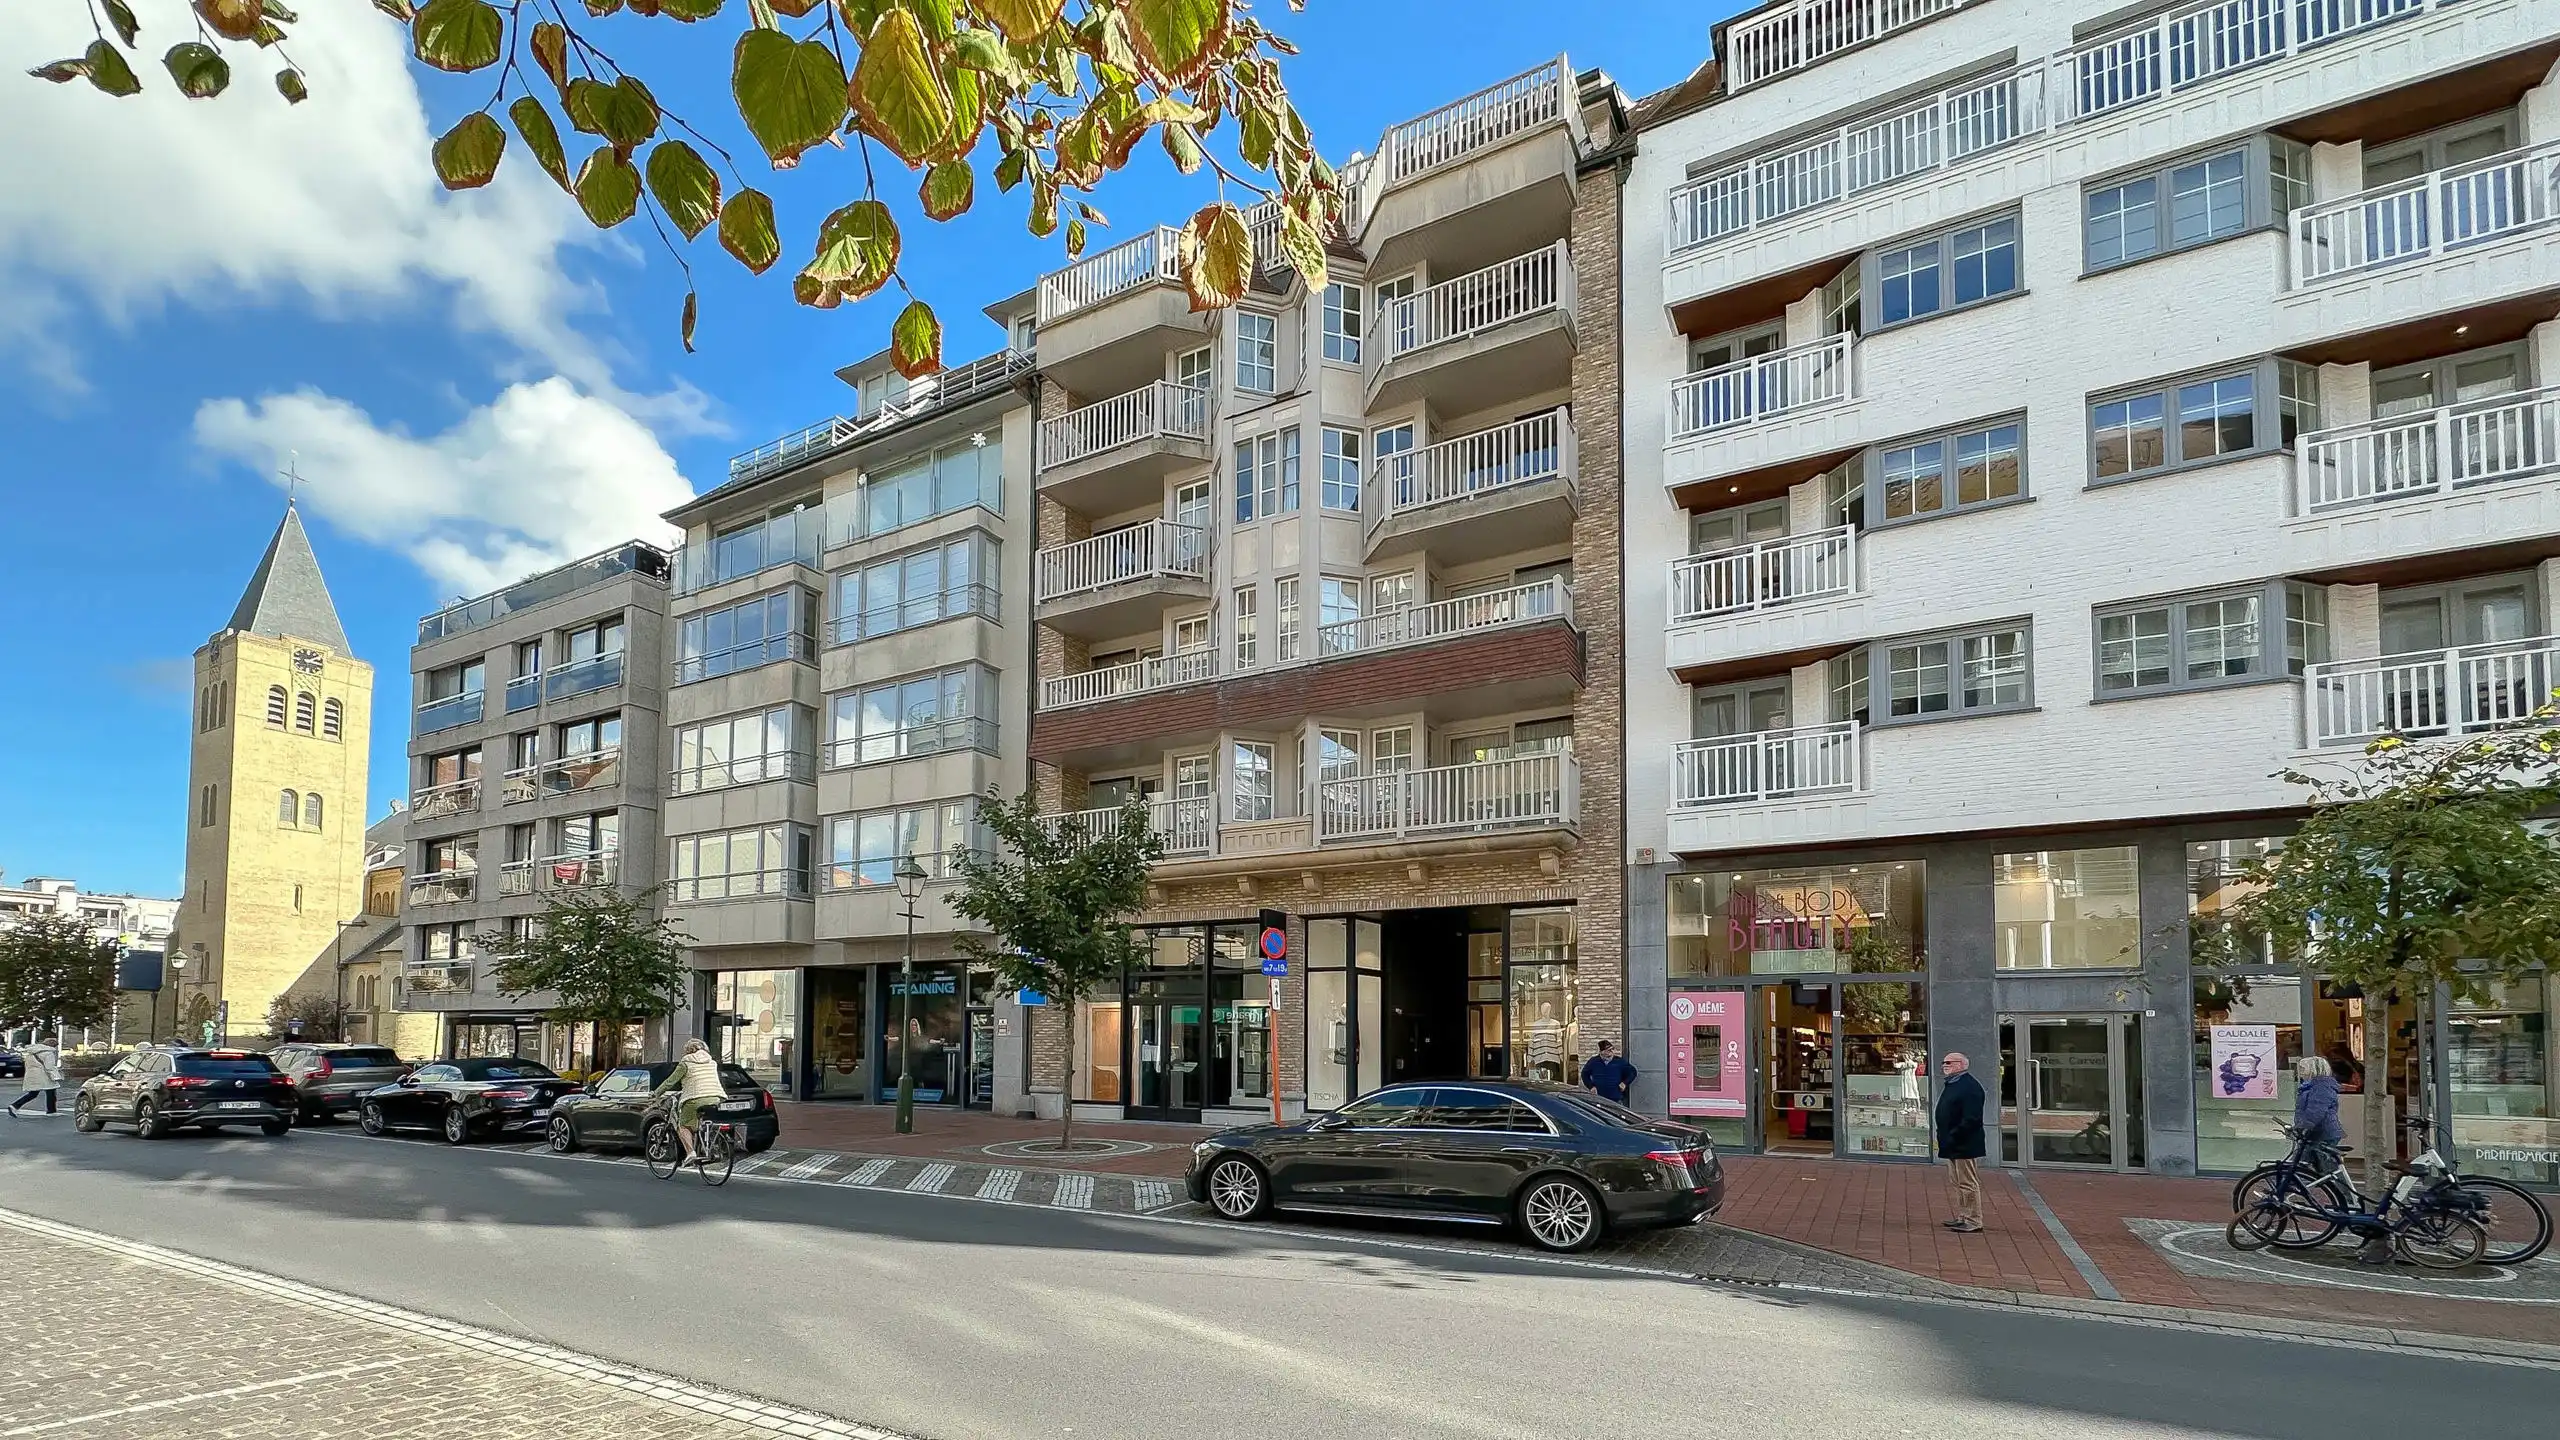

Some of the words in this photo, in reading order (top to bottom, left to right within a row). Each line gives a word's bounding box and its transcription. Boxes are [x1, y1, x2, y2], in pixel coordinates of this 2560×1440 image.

[1795, 888, 1856, 913] BODY
[1728, 914, 1857, 952] BEAUTY
[889, 983, 956, 995] TRAINING
[1697, 1001, 1726, 1014] MÊME
[2475, 1148, 2560, 1163] PARAFARMACIE
